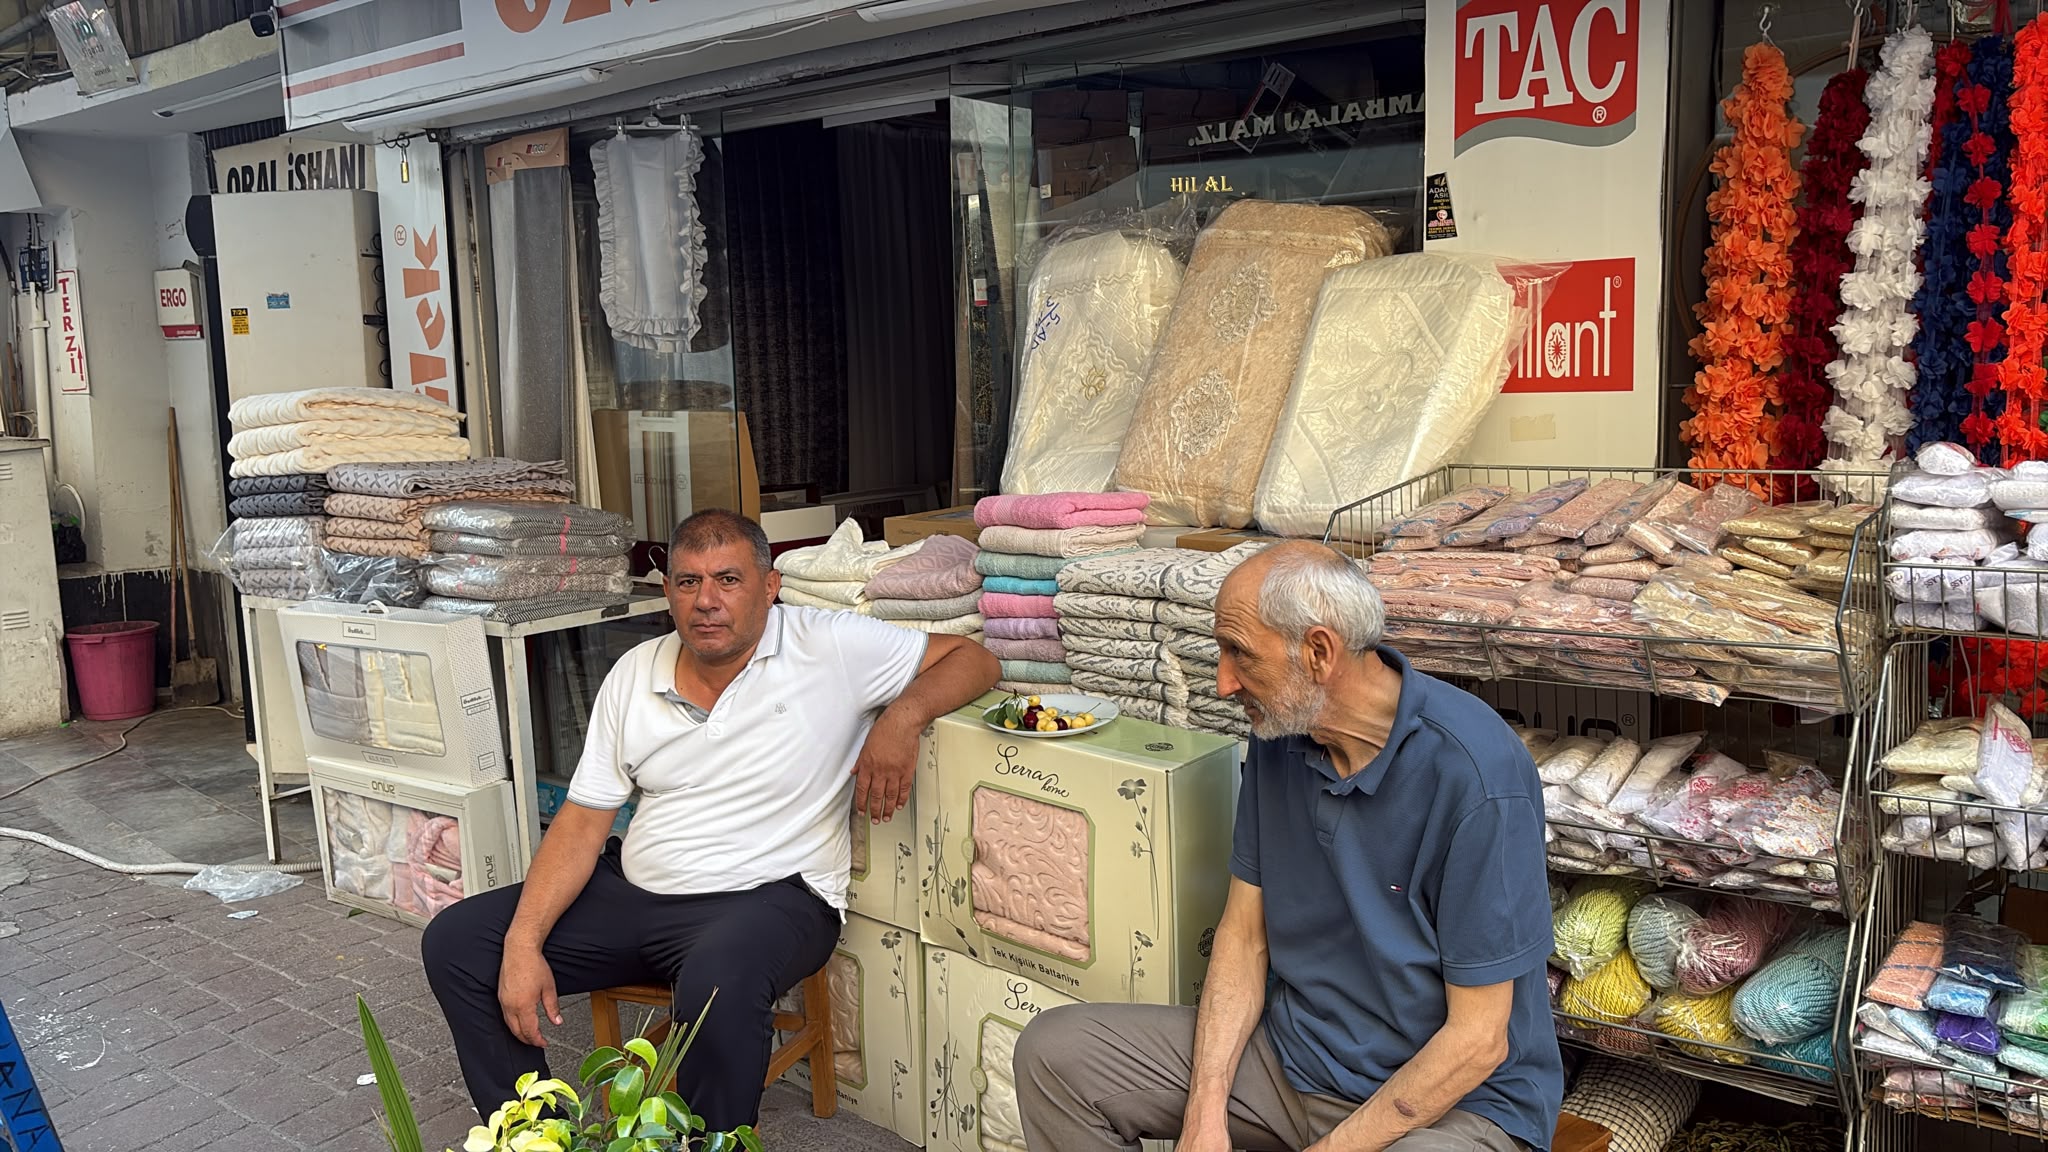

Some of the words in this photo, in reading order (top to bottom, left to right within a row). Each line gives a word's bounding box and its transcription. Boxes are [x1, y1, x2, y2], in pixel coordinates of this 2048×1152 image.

[1465, 0, 1627, 115] TAC
[160, 288, 187, 307] ERGO
[995, 743, 1058, 785] Serra
[1040, 776, 1070, 798] home
[991, 946, 1007, 959] Tek
[1038, 963, 1080, 987] Battaniye
